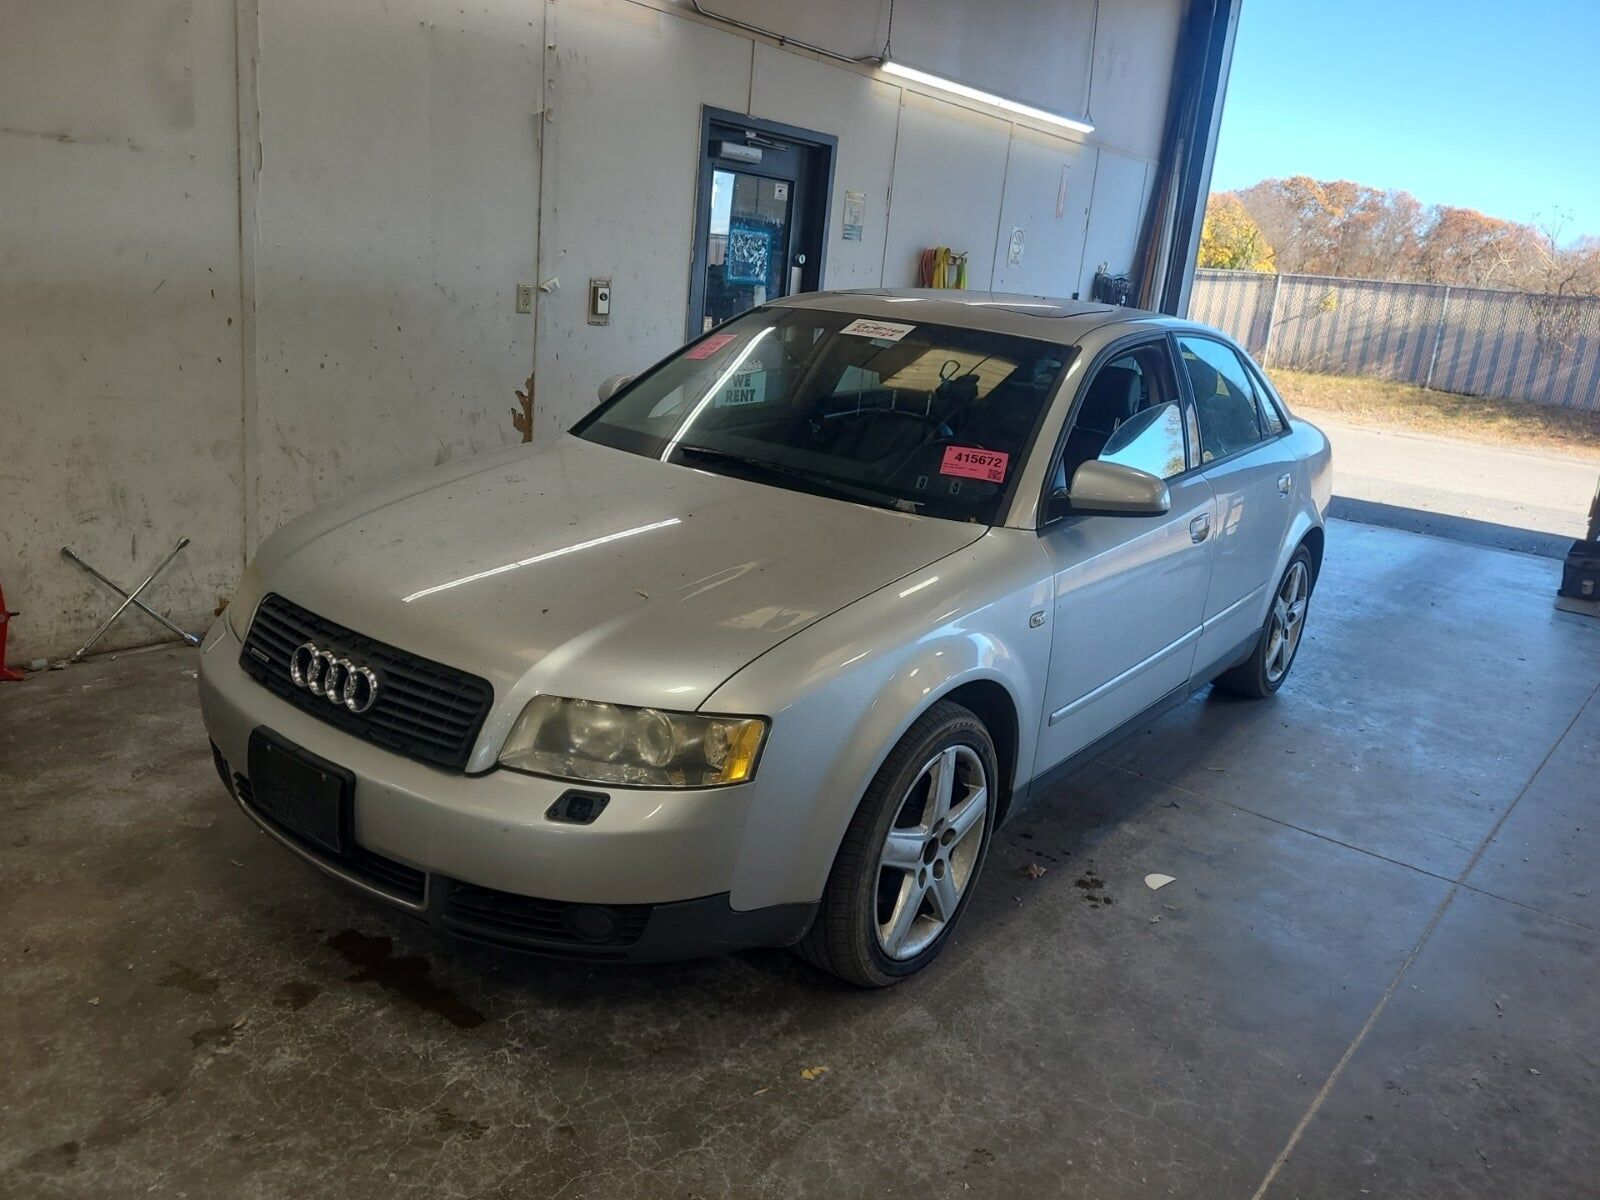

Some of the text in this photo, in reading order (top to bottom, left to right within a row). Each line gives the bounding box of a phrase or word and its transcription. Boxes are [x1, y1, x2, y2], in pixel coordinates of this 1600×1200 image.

[732, 374, 752, 388] WE
[725, 389, 756, 402] RENT
[954, 452, 1002, 468] 415672
